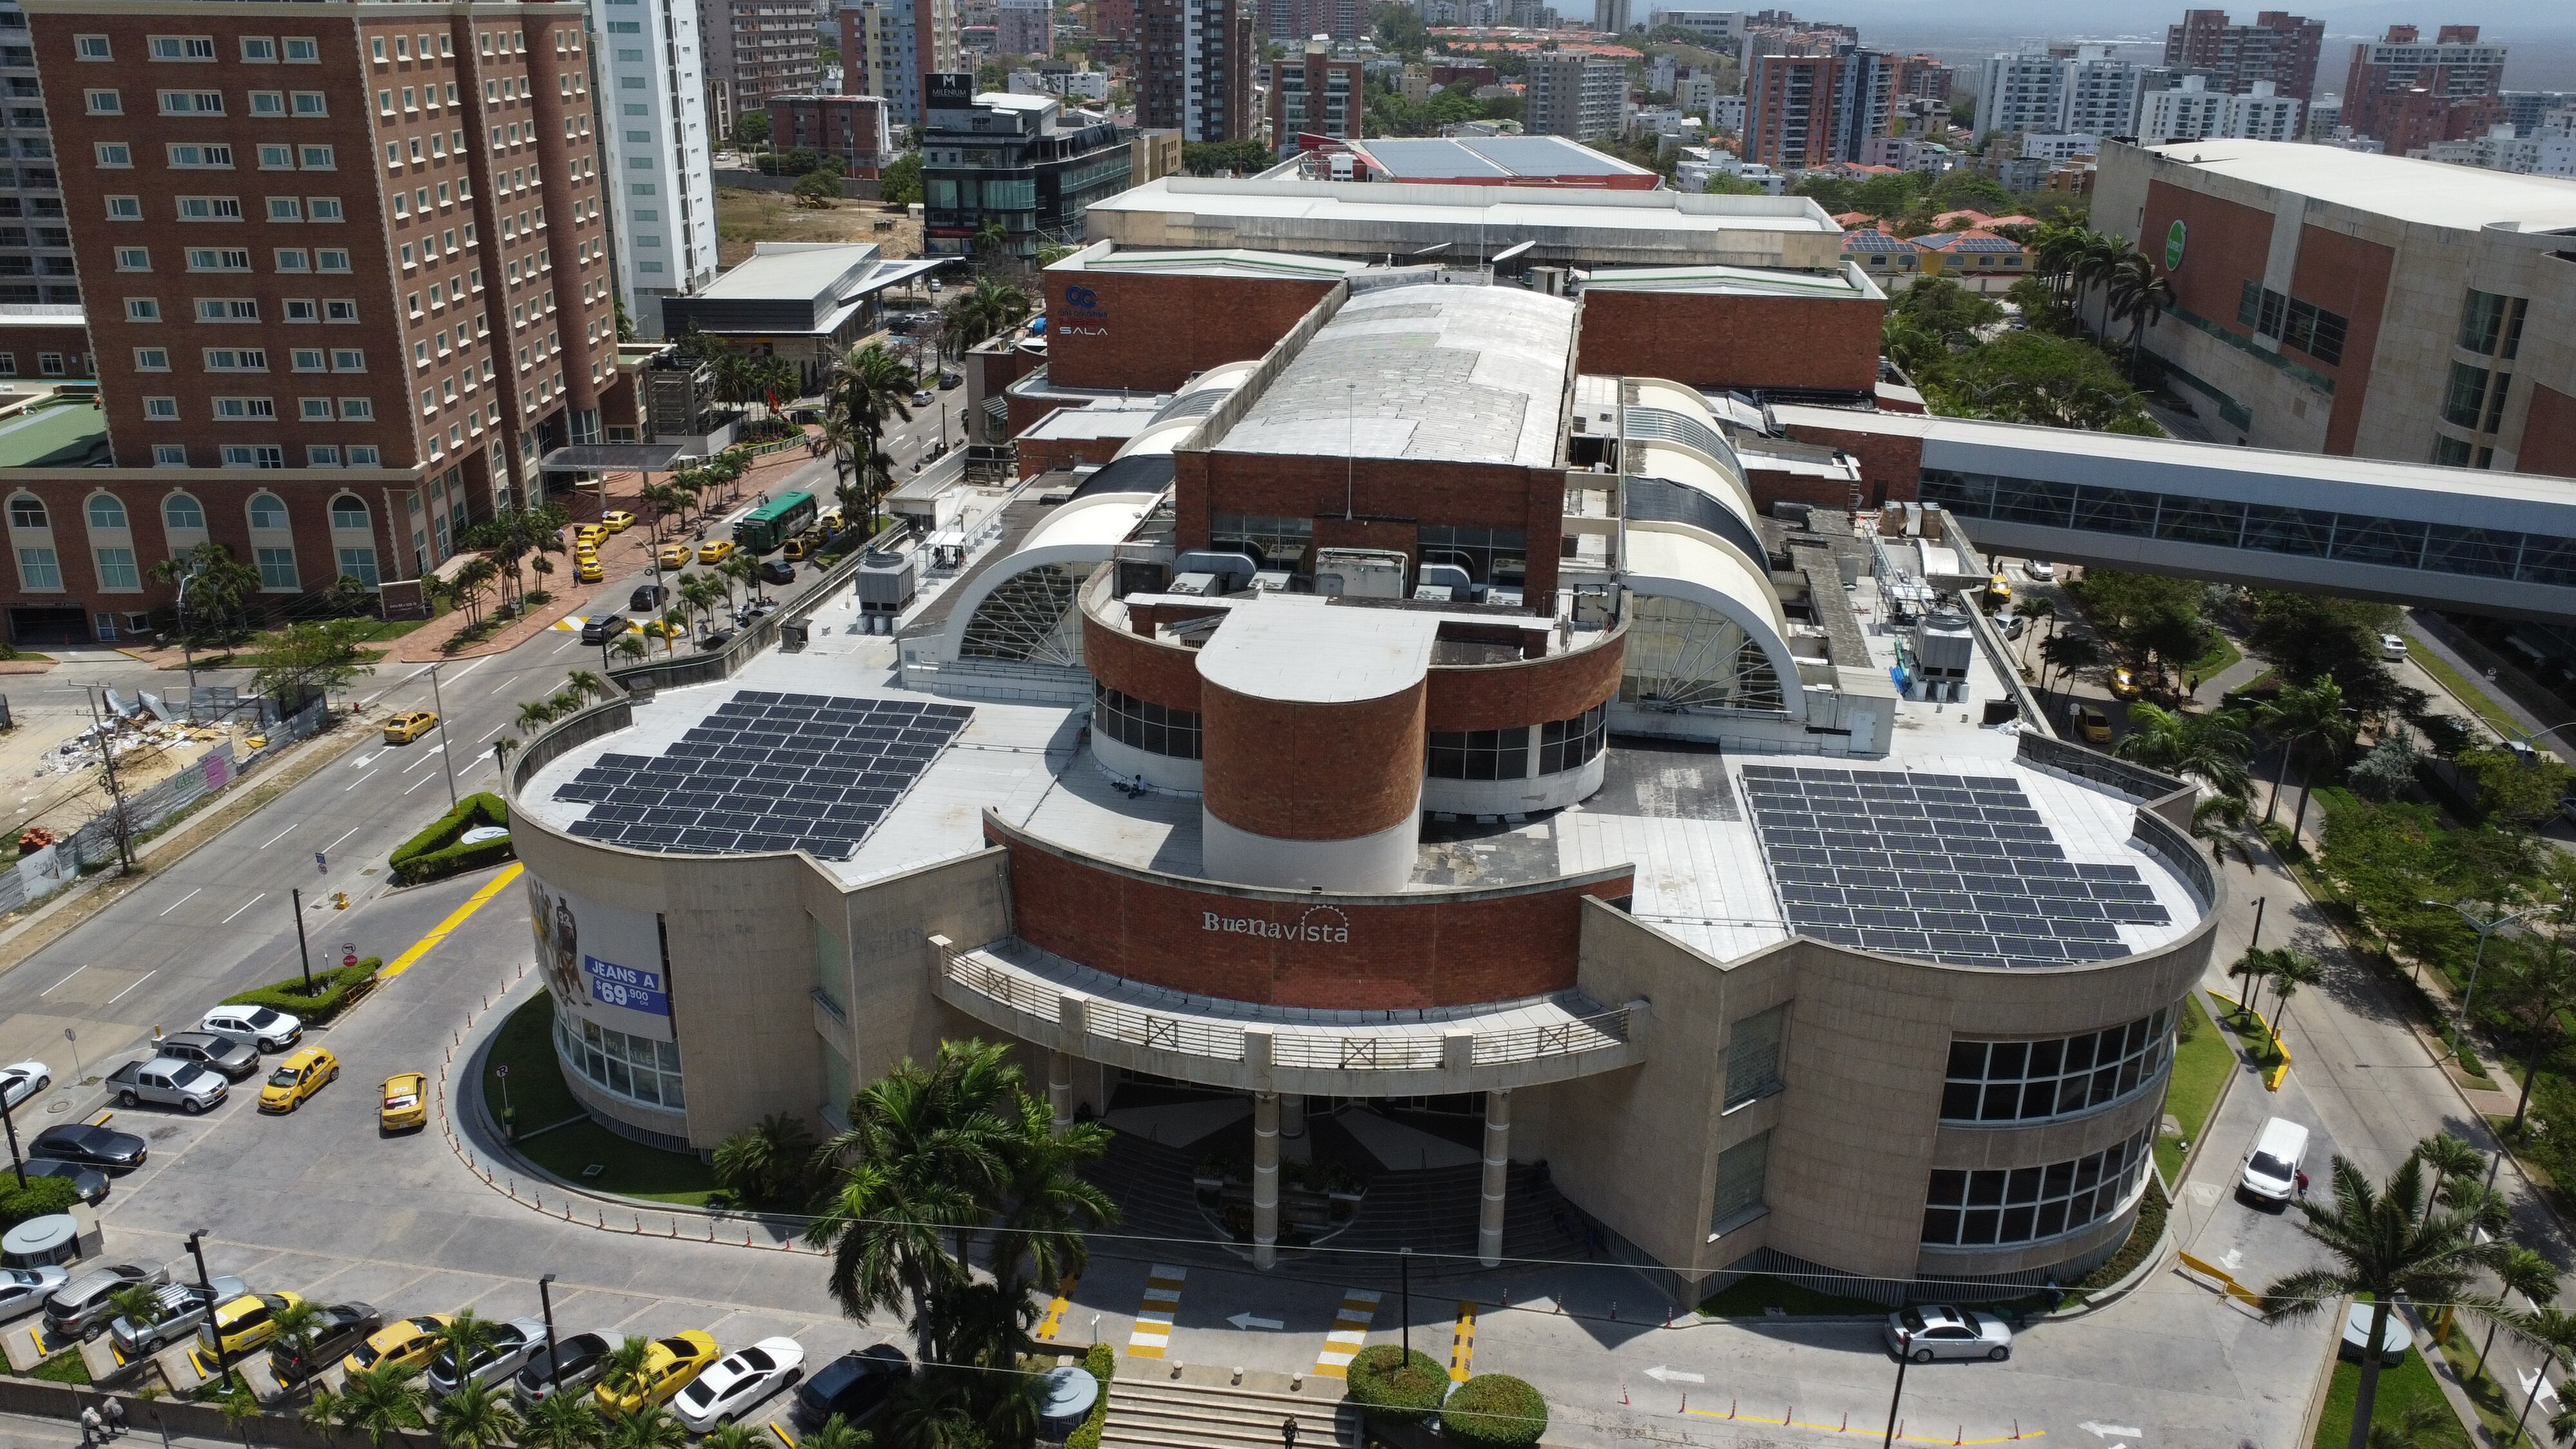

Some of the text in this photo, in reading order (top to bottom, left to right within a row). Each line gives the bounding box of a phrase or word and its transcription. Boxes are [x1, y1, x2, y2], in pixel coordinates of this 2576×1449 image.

[1059, 327, 1108, 335] SALA
[1202, 911, 1349, 943] Buenavista
[592, 961, 655, 988] JEANS A
